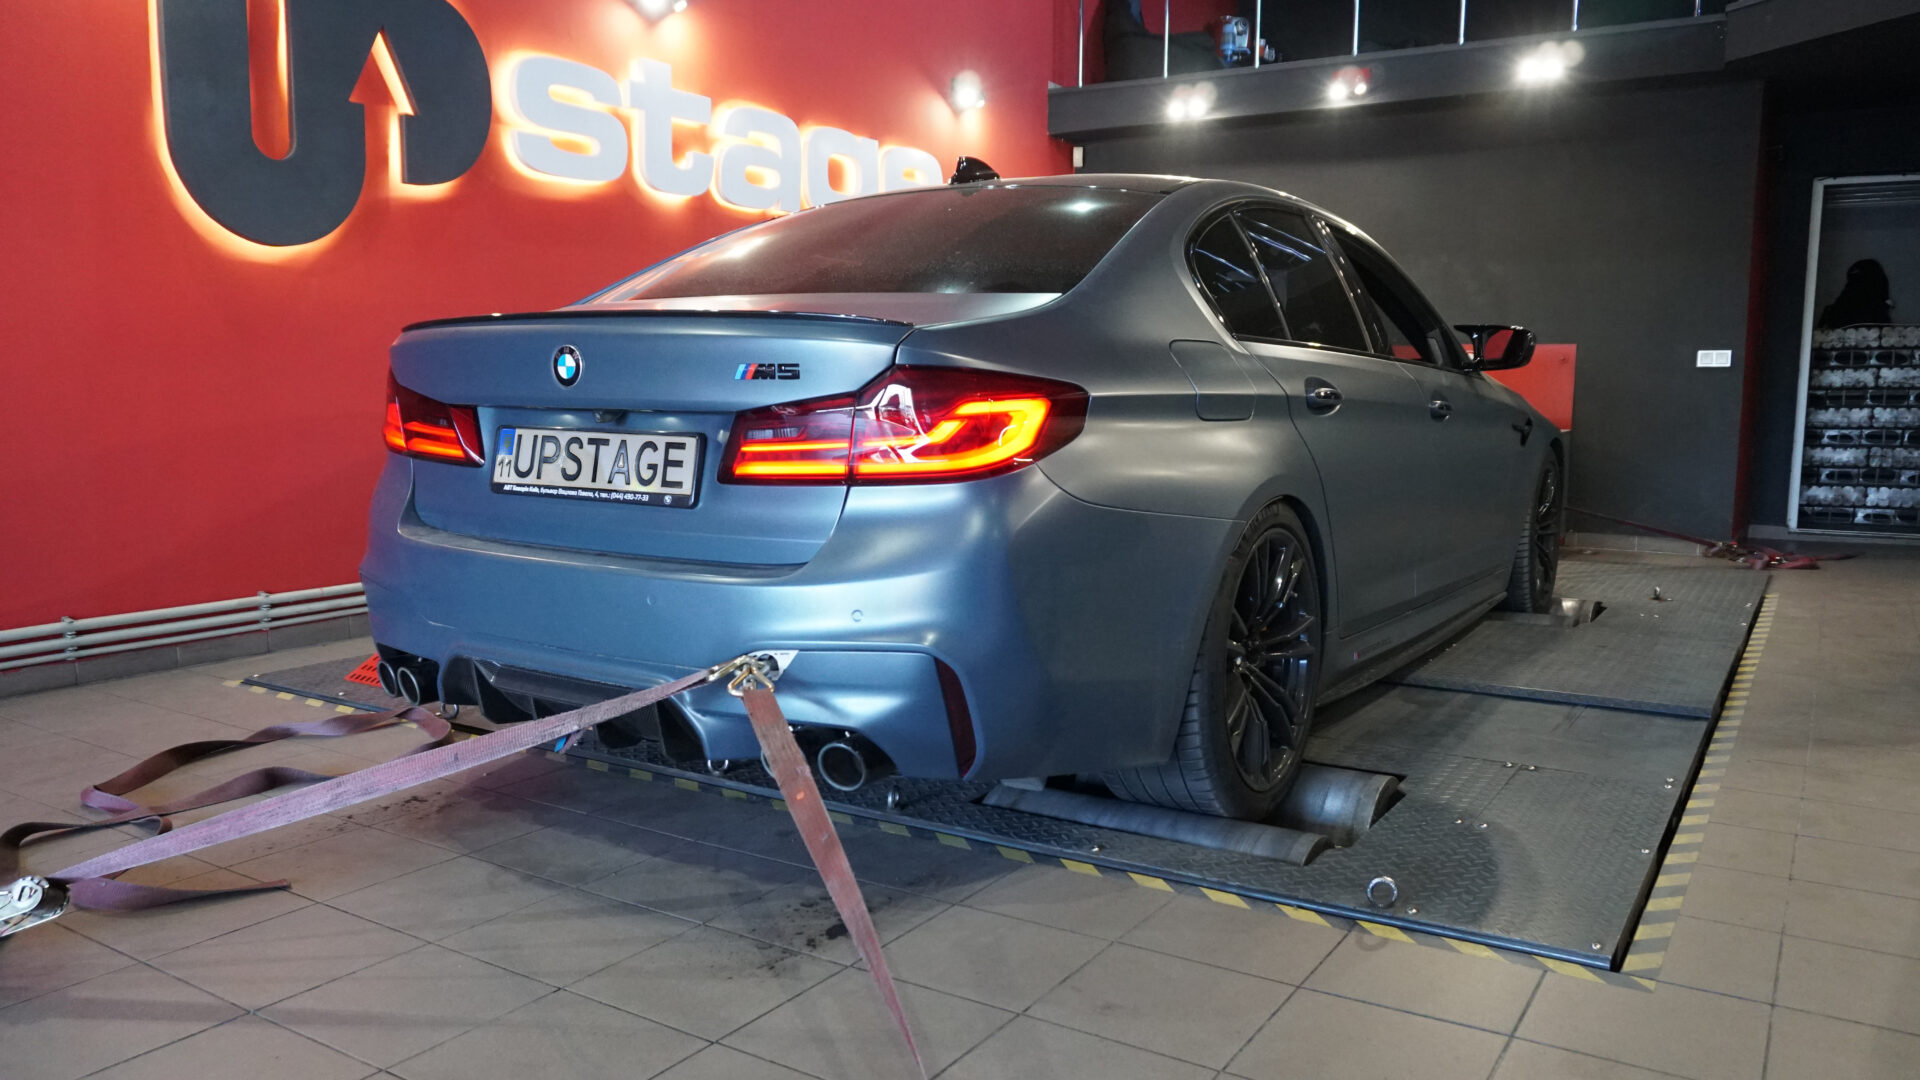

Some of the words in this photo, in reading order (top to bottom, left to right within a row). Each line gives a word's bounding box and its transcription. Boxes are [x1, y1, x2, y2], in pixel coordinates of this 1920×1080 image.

[751, 363, 800, 380] M5
[513, 433, 687, 489] UPSTAGE
[611, 492, 623, 500] (044)
